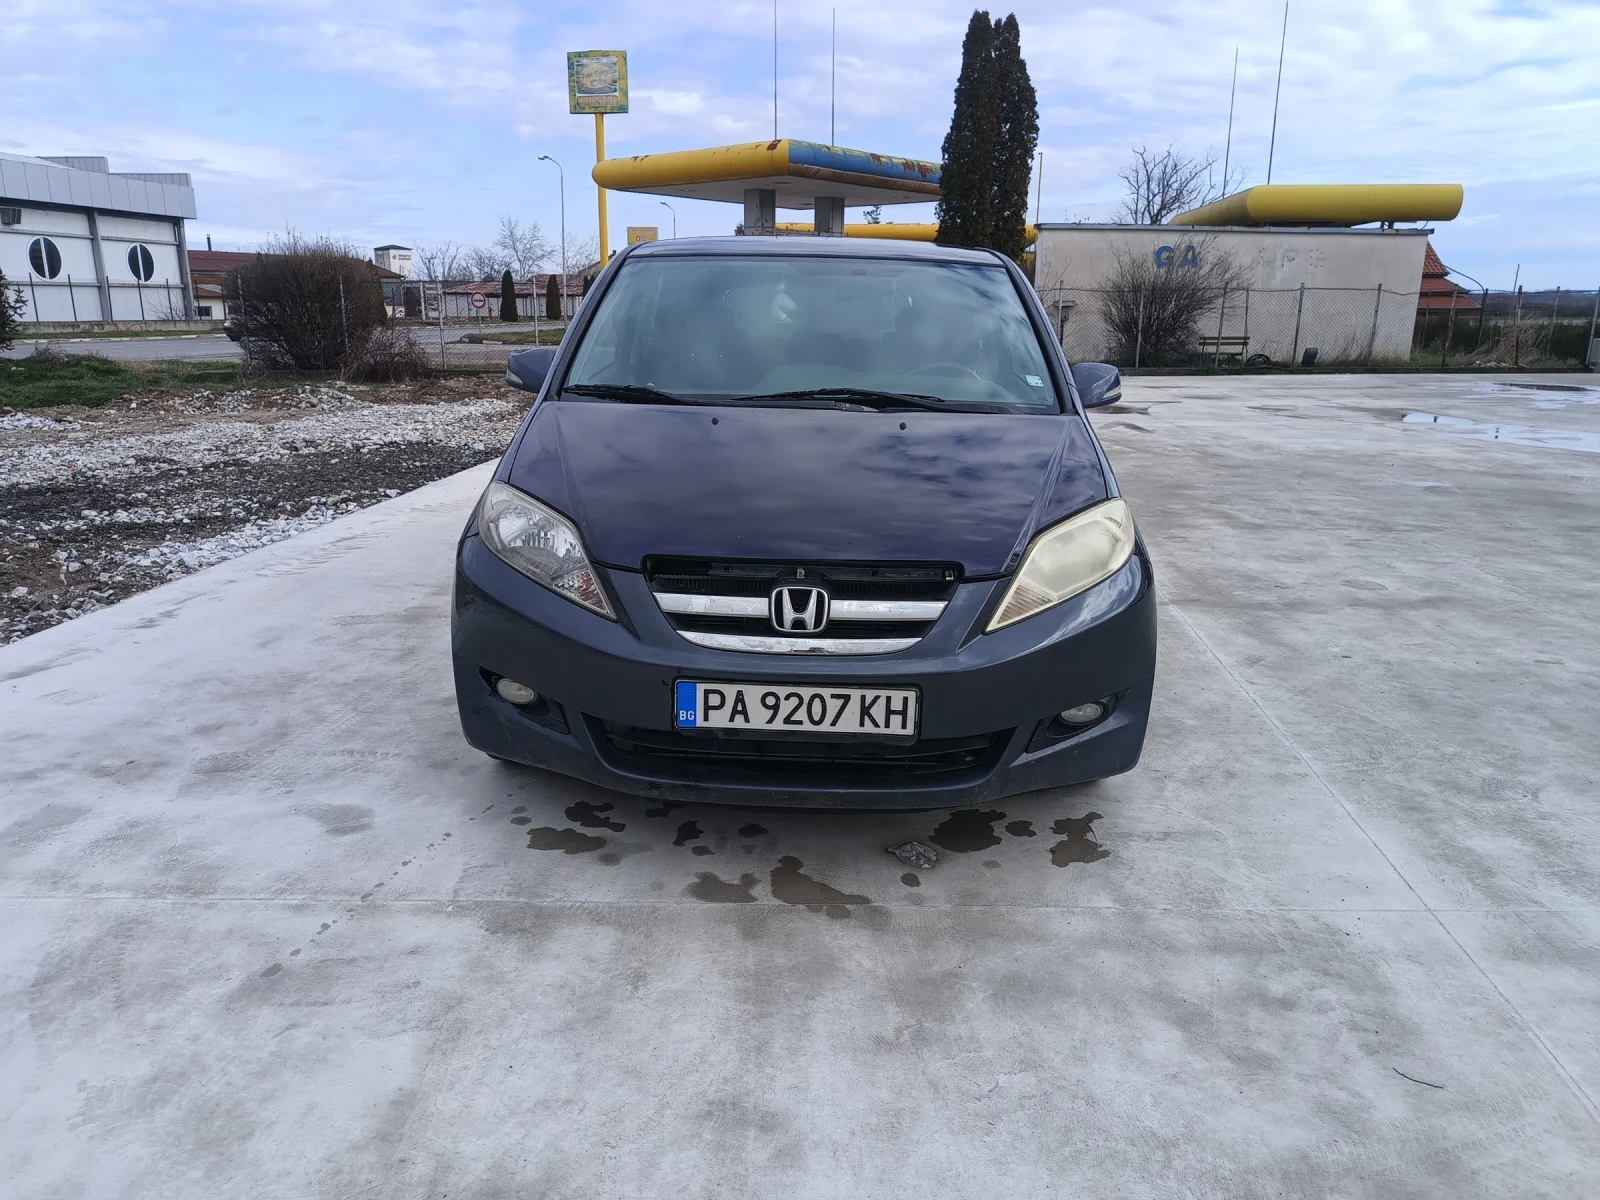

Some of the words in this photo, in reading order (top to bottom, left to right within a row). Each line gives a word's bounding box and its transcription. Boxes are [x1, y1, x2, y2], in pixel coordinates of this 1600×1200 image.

[679, 710, 695, 721] BG
[703, 688, 750, 723] PA
[760, 691, 851, 727] 9207
[859, 694, 909, 730] KH
